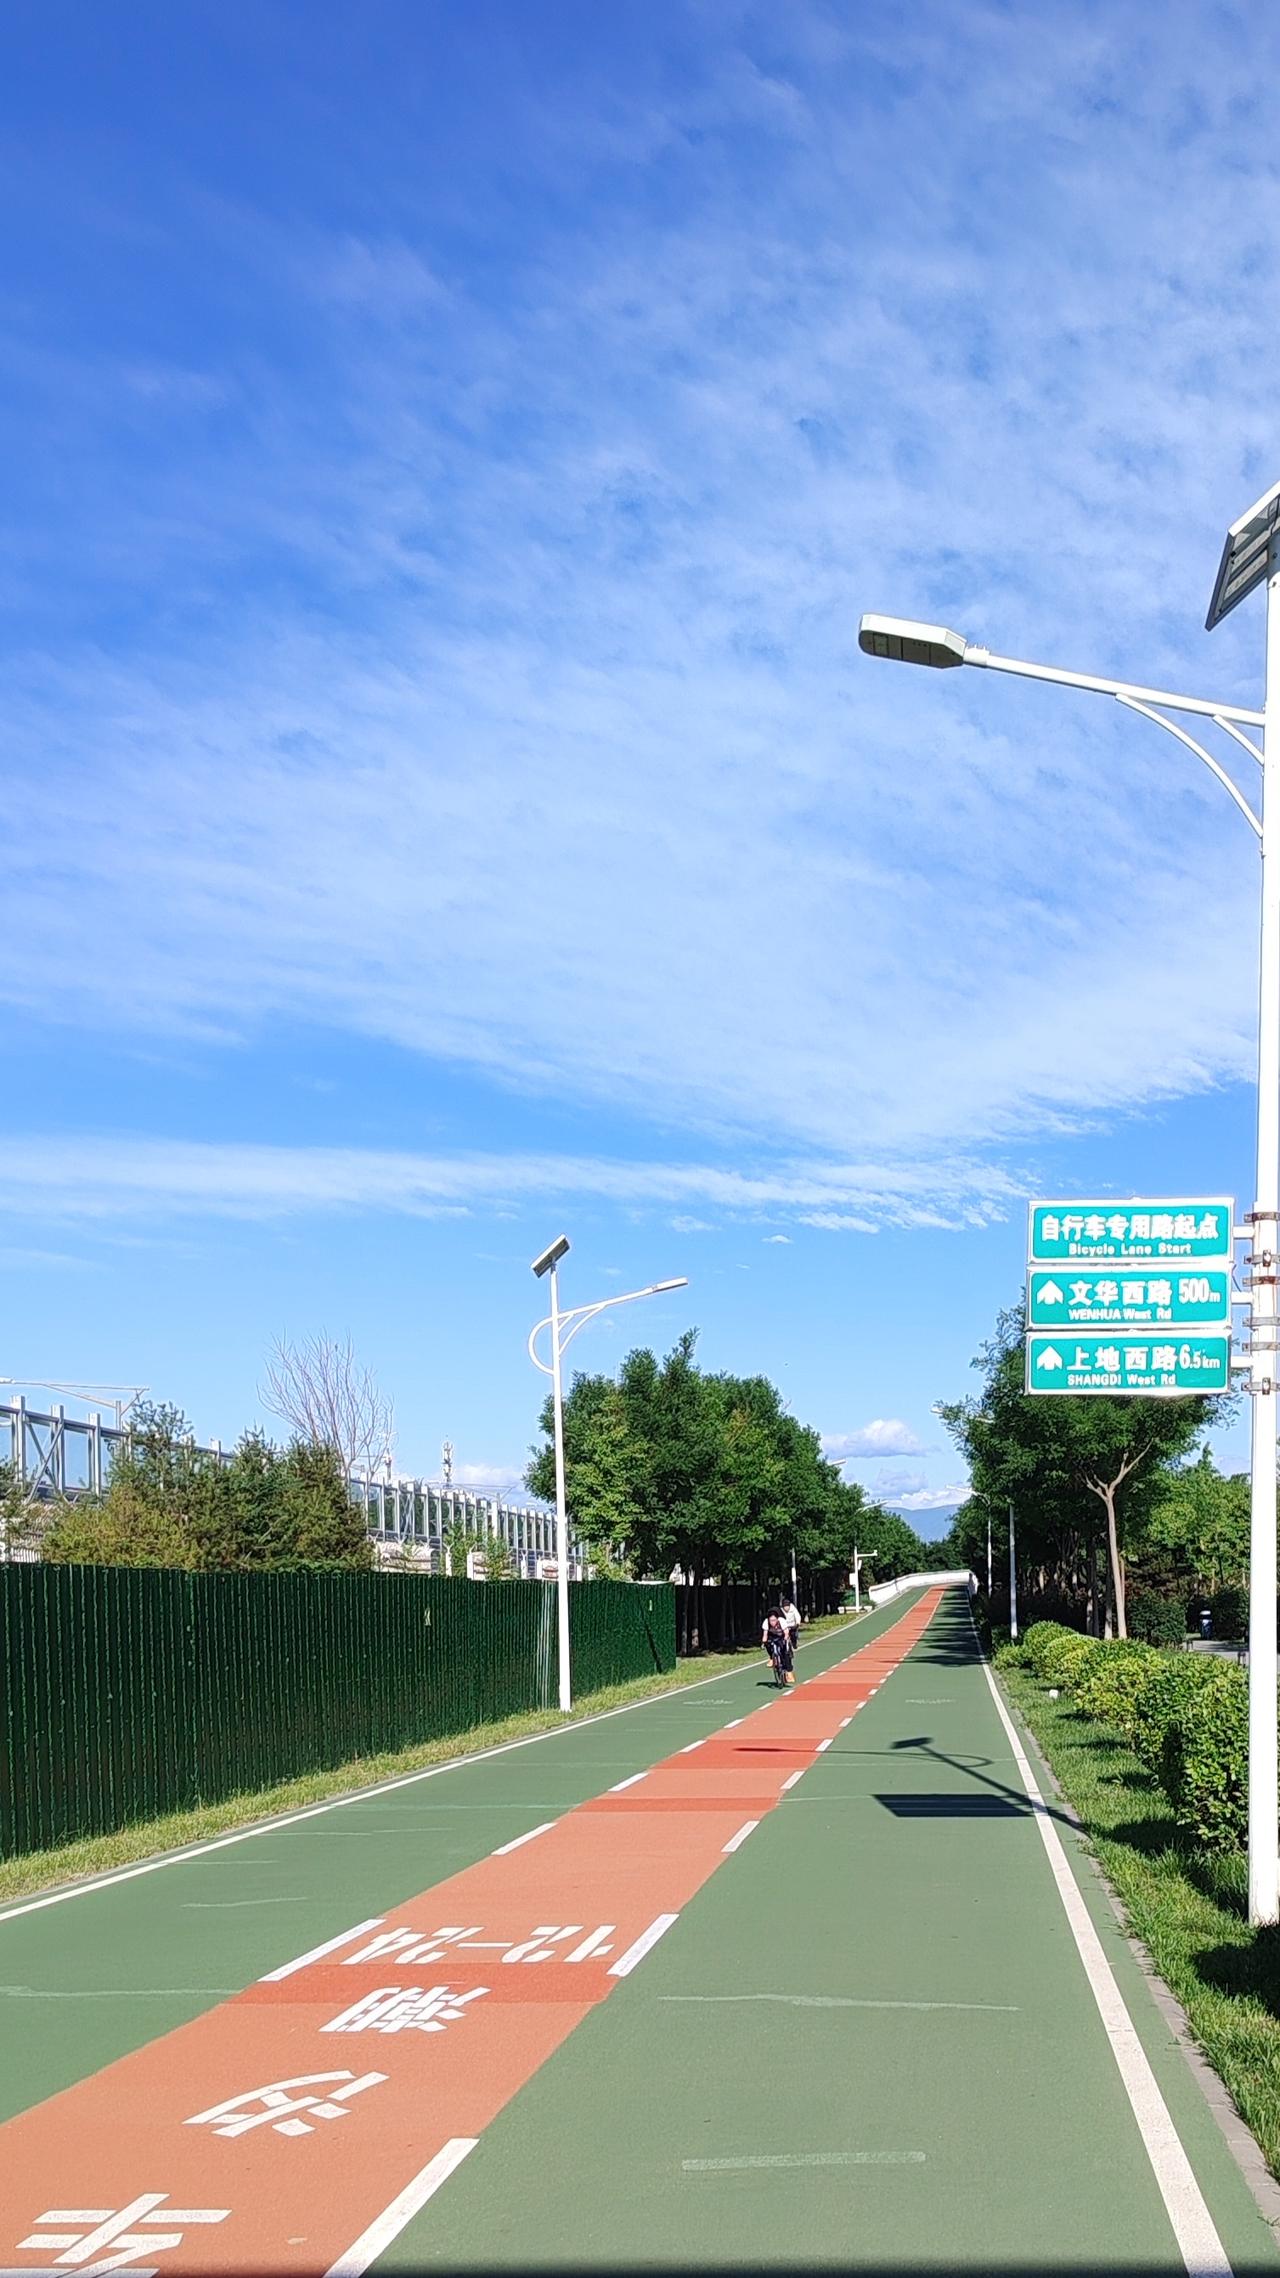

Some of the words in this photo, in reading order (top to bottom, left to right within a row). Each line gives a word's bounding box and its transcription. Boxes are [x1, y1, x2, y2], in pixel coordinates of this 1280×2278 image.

[1041, 1213, 1219, 1241] 自行车专用路起点
[1069, 1243, 1115, 1256] Bicycle
[1121, 1244, 1152, 1255] Lane
[1158, 1242, 1192, 1254] Start
[1069, 1279, 1172, 1306] 文华西路
[1178, 1277, 1221, 1304] 500m
[1069, 1309, 1121, 1320] WENHUA
[1123, 1308, 1151, 1319] West
[1156, 1307, 1172, 1319] Rd
[1067, 1345, 1178, 1372] 上地西路
[1067, 1373, 1122, 1385] SHANGDI
[1128, 1373, 1155, 1385] West
[1161, 1373, 1176, 1384] Rd
